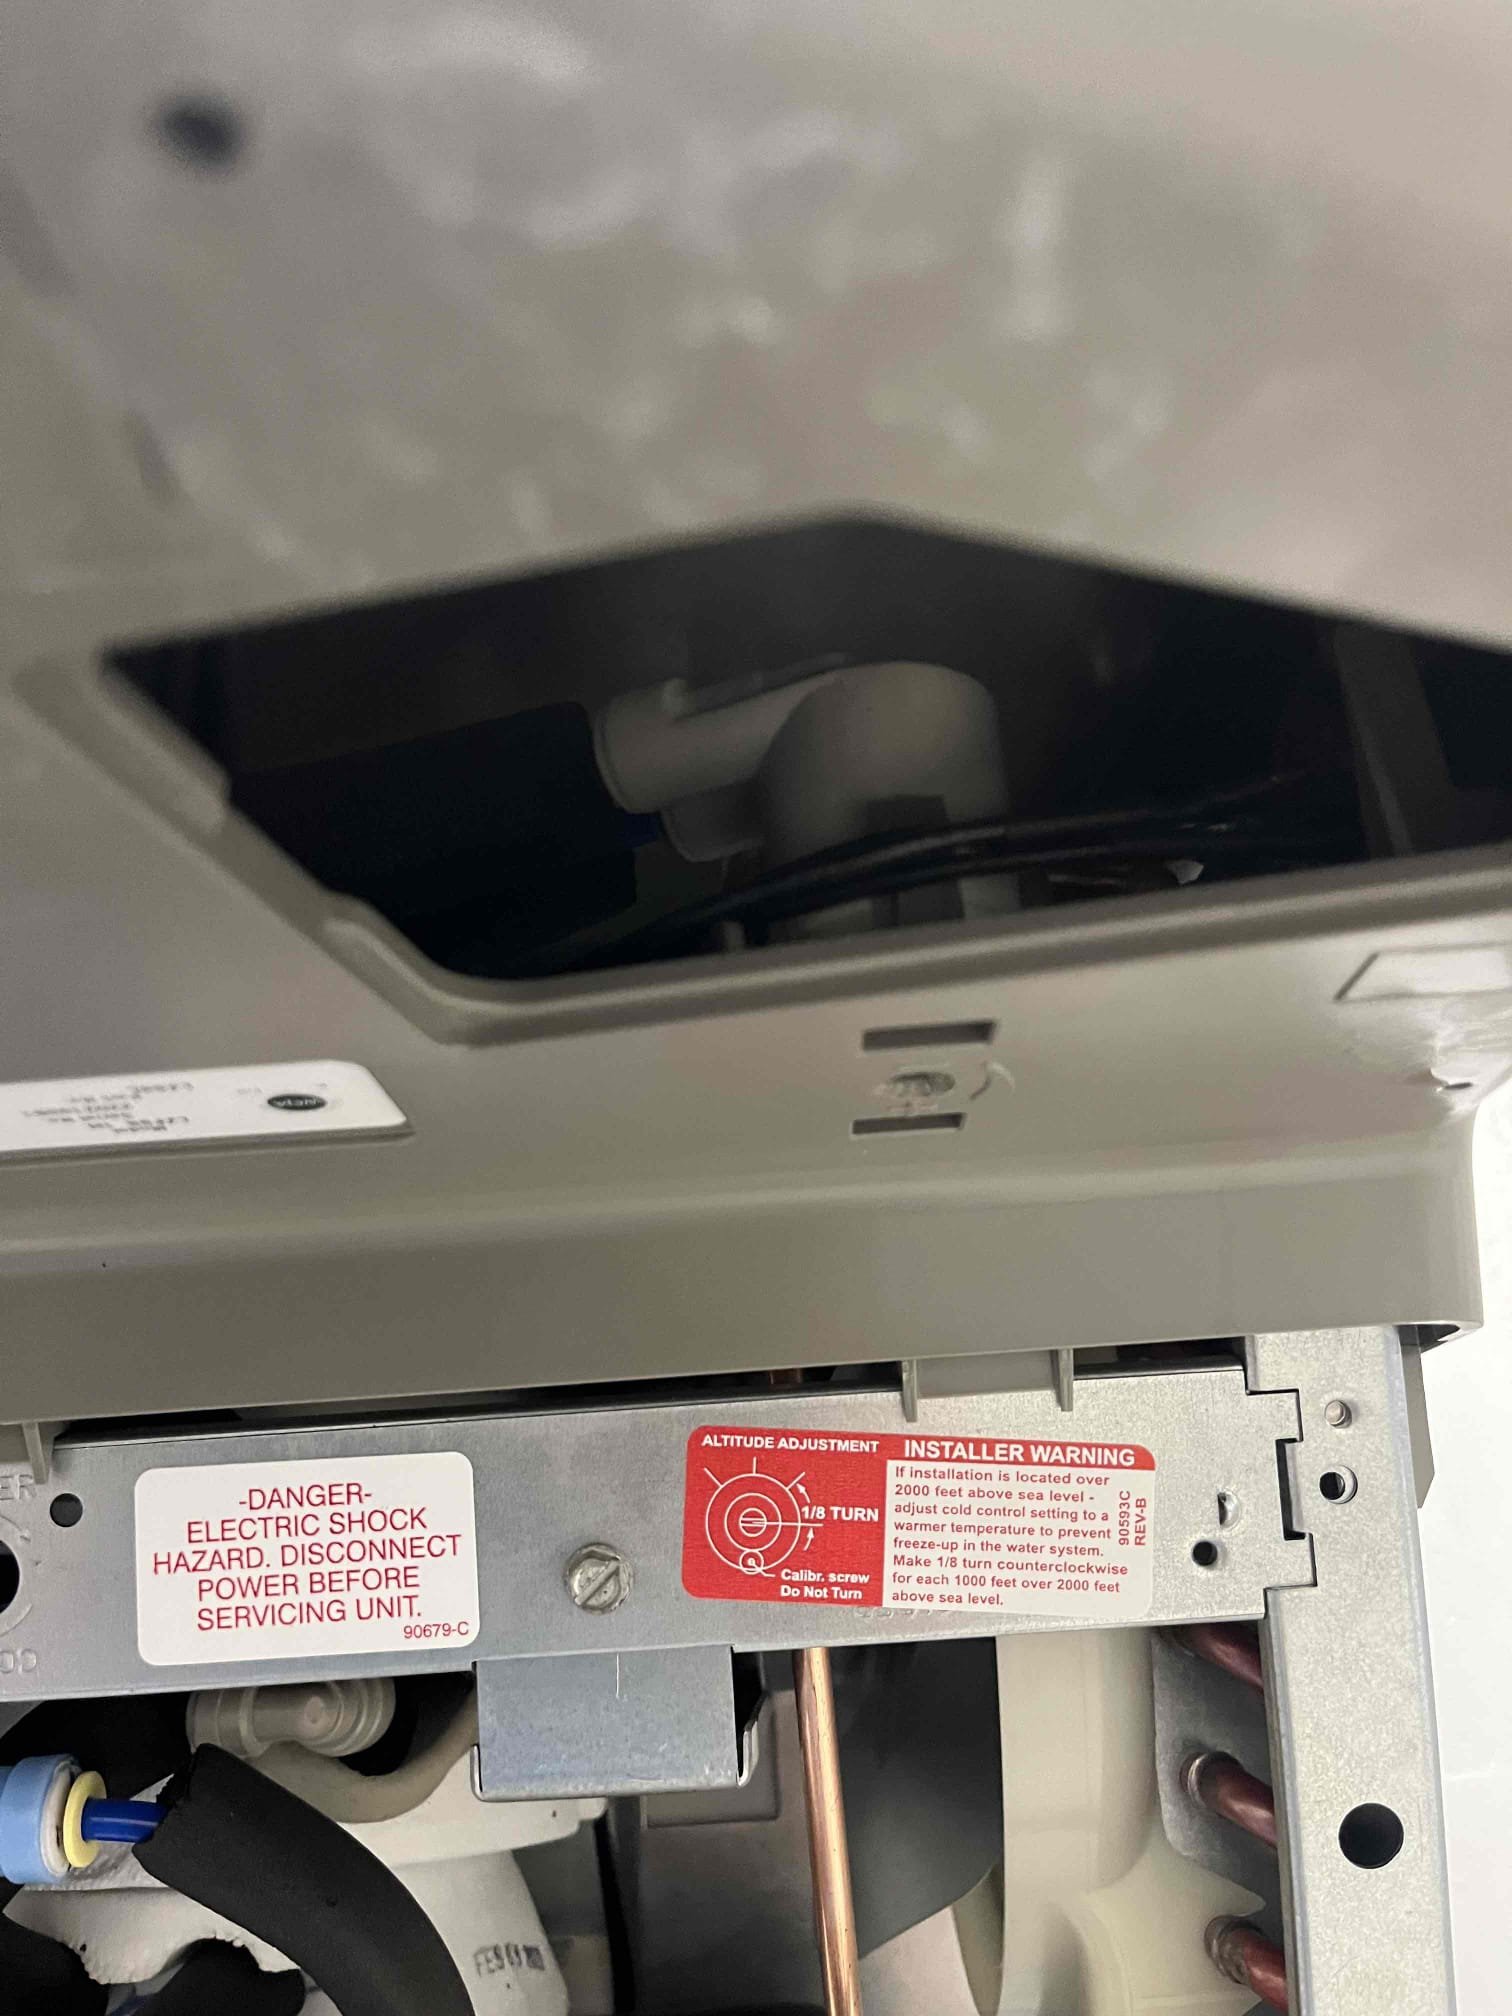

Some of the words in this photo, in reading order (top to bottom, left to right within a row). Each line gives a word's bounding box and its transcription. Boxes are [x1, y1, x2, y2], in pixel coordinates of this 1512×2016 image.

[702, 1434, 775, 1449] ALTITUDE
[777, 1437, 880, 1453] ADJUSTMENT
[905, 1440, 1025, 1462] INSTALLER
[1030, 1445, 1135, 1467] WARNING
[896, 1466, 906, 1478] If
[910, 1466, 993, 1482] installation
[999, 1470, 1011, 1482] is
[1016, 1471, 1071, 1485] located
[1076, 1476, 1110, 1486] over
[239, 1483, 373, 1511] -DANGER-
[895, 1484, 930, 1497] 2000
[935, 1486, 963, 1498] feet
[968, 1488, 1013, 1500] above
[1018, 1492, 1045, 1501] sea
[1050, 1490, 1085, 1503] level
[801, 1506, 826, 1520] 1/8
[830, 1507, 879, 1522] TURN
[895, 1502, 938, 1517] adjust
[942, 1504, 972, 1516] cold
[977, 1506, 1026, 1518] control
[1031, 1508, 1079, 1523] setting
[1083, 1510, 1097, 1521] to
[1101, 1513, 1109, 1522] a
[1118, 1491, 1131, 1546] 90593C
[1135, 1498, 1147, 1546] REV-B
[188, 1513, 321, 1545] ELECTRIC
[330, 1507, 428, 1535] SHOCK
[894, 1522, 946, 1534] warmer
[951, 1523, 1036, 1537] temperature
[1040, 1526, 1053, 1537] to
[1058, 1529, 1111, 1541] prevent
[153, 1547, 271, 1575] HAZARD.
[281, 1534, 462, 1568] DISCONNECT
[894, 1537, 959, 1553] freeze-up
[964, 1541, 976, 1551] in
[981, 1541, 1002, 1552] the
[1006, 1543, 1045, 1554] water
[1050, 1546, 1104, 1558] system.
[894, 1554, 932, 1567] Make
[938, 1556, 958, 1569] 1/8
[963, 1558, 993, 1569] turn
[998, 1561, 1129, 1576] counterclockwise
[199, 1574, 299, 1602] POWER
[310, 1566, 421, 1595] BEFORE
[781, 1569, 825, 1583] Calibr.
[828, 1572, 871, 1584] screw
[893, 1572, 913, 1584] for
[916, 1574, 949, 1585] each
[955, 1575, 987, 1587] 1000
[991, 1576, 1017, 1588] feet
[1022, 1580, 1053, 1590] over
[1057, 1579, 1089, 1591] 2000
[1094, 1580, 1120, 1593] feet
[780, 1585, 801, 1597] Do
[804, 1586, 828, 1598] Not
[831, 1587, 863, 1600] Turn
[892, 1590, 935, 1603] above
[939, 1594, 963, 1604] sea
[968, 1593, 1004, 1606] level.
[198, 1600, 347, 1631] SERVICING
[356, 1595, 421, 1621] UNIT.
[403, 1621, 470, 1639] 90679-C
